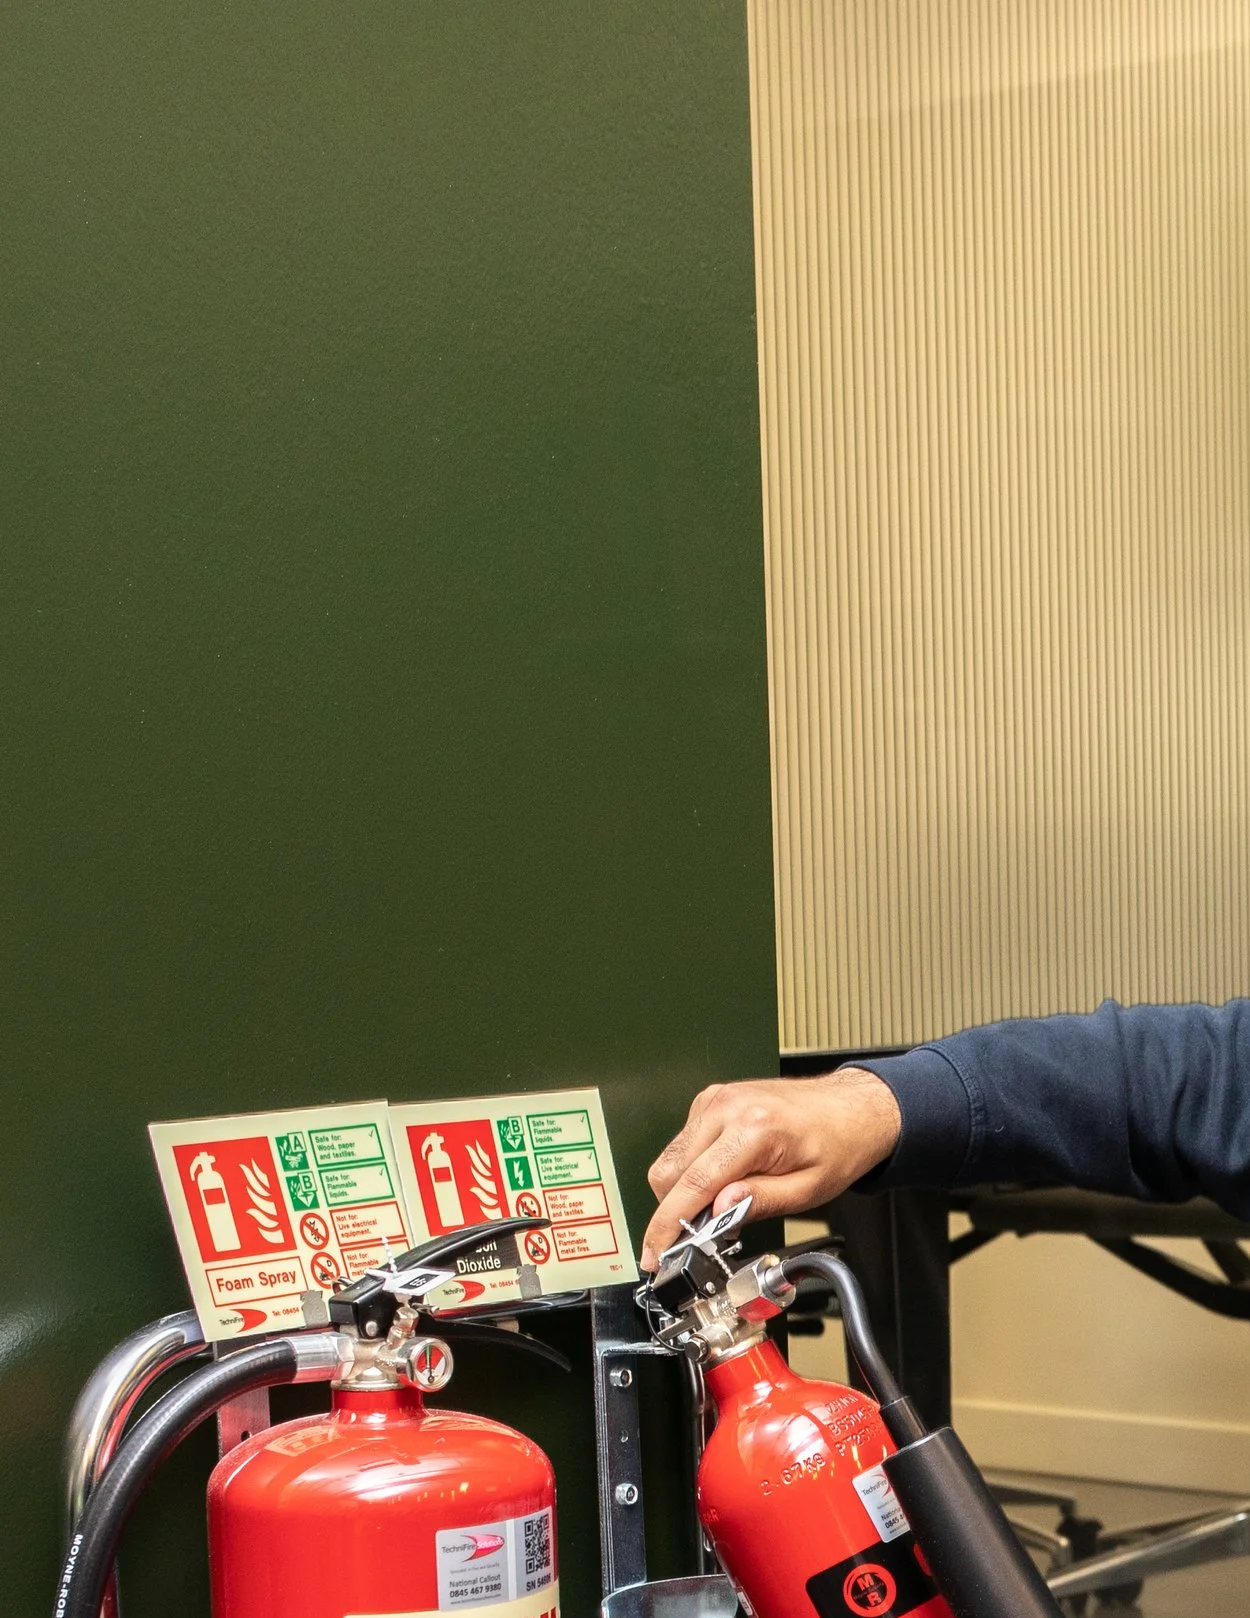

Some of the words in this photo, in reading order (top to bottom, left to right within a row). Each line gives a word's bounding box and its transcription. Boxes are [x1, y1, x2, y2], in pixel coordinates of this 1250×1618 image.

[512, 1120, 520, 1132] B
[533, 1126, 562, 1135] Flammable
[293, 1135, 304, 1150] A
[315, 1134, 329, 1143] Safe
[331, 1133, 342, 1142] for:
[338, 1142, 355, 1150] paper
[320, 1152, 331, 1160] and
[554, 1162, 579, 1171] electrical
[303, 1175, 313, 1189] B
[325, 1174, 339, 1183] Safe
[327, 1182, 357, 1191] Flammable
[569, 1200, 584, 1208] paper
[336, 1214, 346, 1222] Not
[338, 1223, 350, 1231] Live
[352, 1219, 378, 1228] electrical
[341, 1228, 372, 1239] equipment.
[558, 1238, 587, 1246] Flammable
[349, 1259, 379, 1268] Flammable
[456, 1256, 501, 1274] Dioxide
[216, 1277, 254, 1292] Foam
[258, 1270, 296, 1288] Spray
[441, 1544, 476, 1554] TechniFire
[449, 1577, 478, 1588] National
[480, 1574, 501, 1583] Callout
[857, 1573, 874, 1591] M
[450, 1588, 468, 1598] 0845
[470, 1586, 483, 1594] 467
[485, 1583, 502, 1592] 9380
[526, 1581, 536, 1592] SN
[866, 1591, 882, 1607] R
